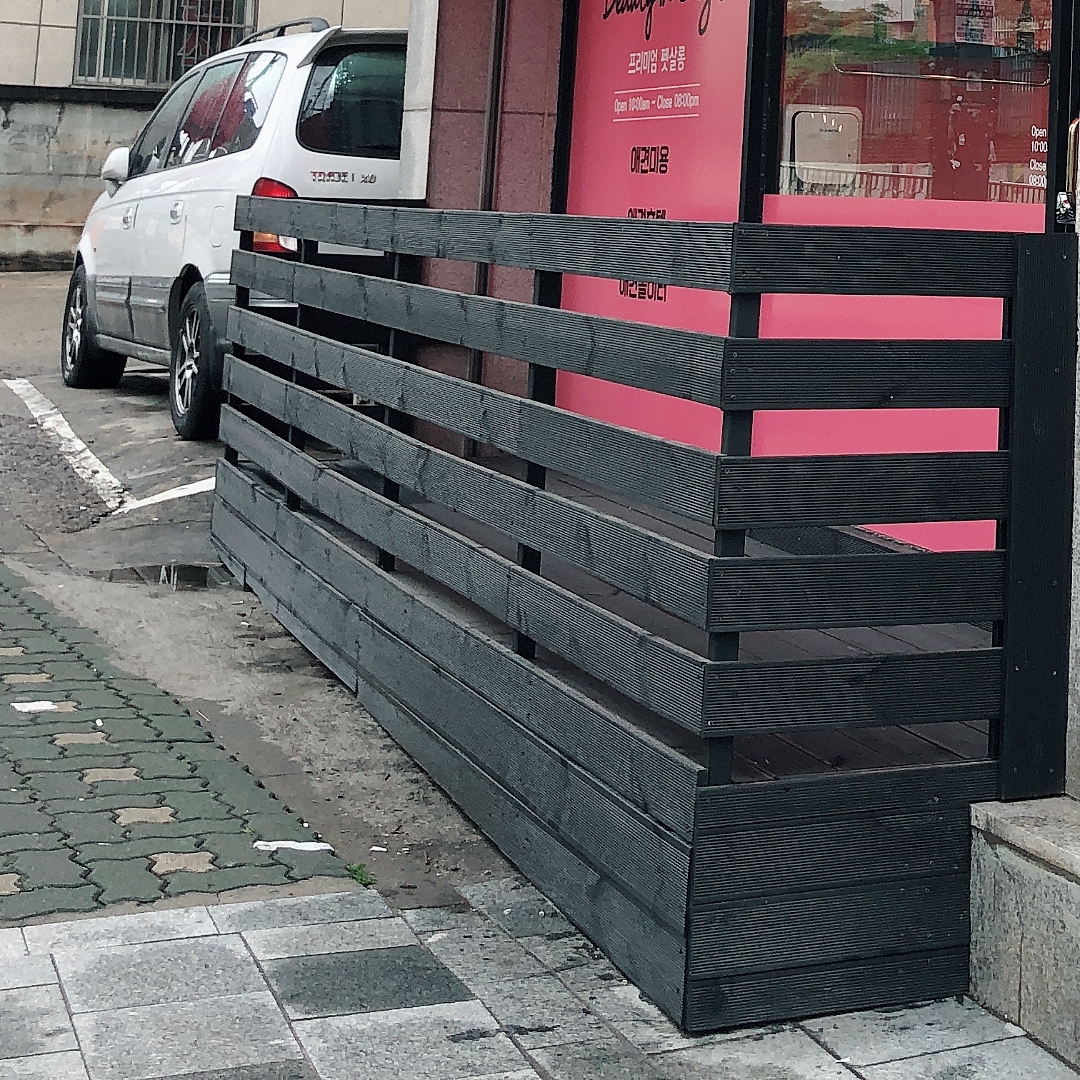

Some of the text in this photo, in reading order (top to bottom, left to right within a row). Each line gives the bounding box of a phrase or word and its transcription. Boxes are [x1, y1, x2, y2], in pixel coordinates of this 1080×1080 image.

[627, 45, 687, 74] 프리미엄 펫살롱
[614, 98, 627, 114] Open
[656, 94, 672, 109] Close
[1031, 125, 1047, 139] Open
[1031, 140, 1048, 153] 10:00
[630, 145, 669, 174] 애견미용
[1029, 158, 1047, 172] Close
